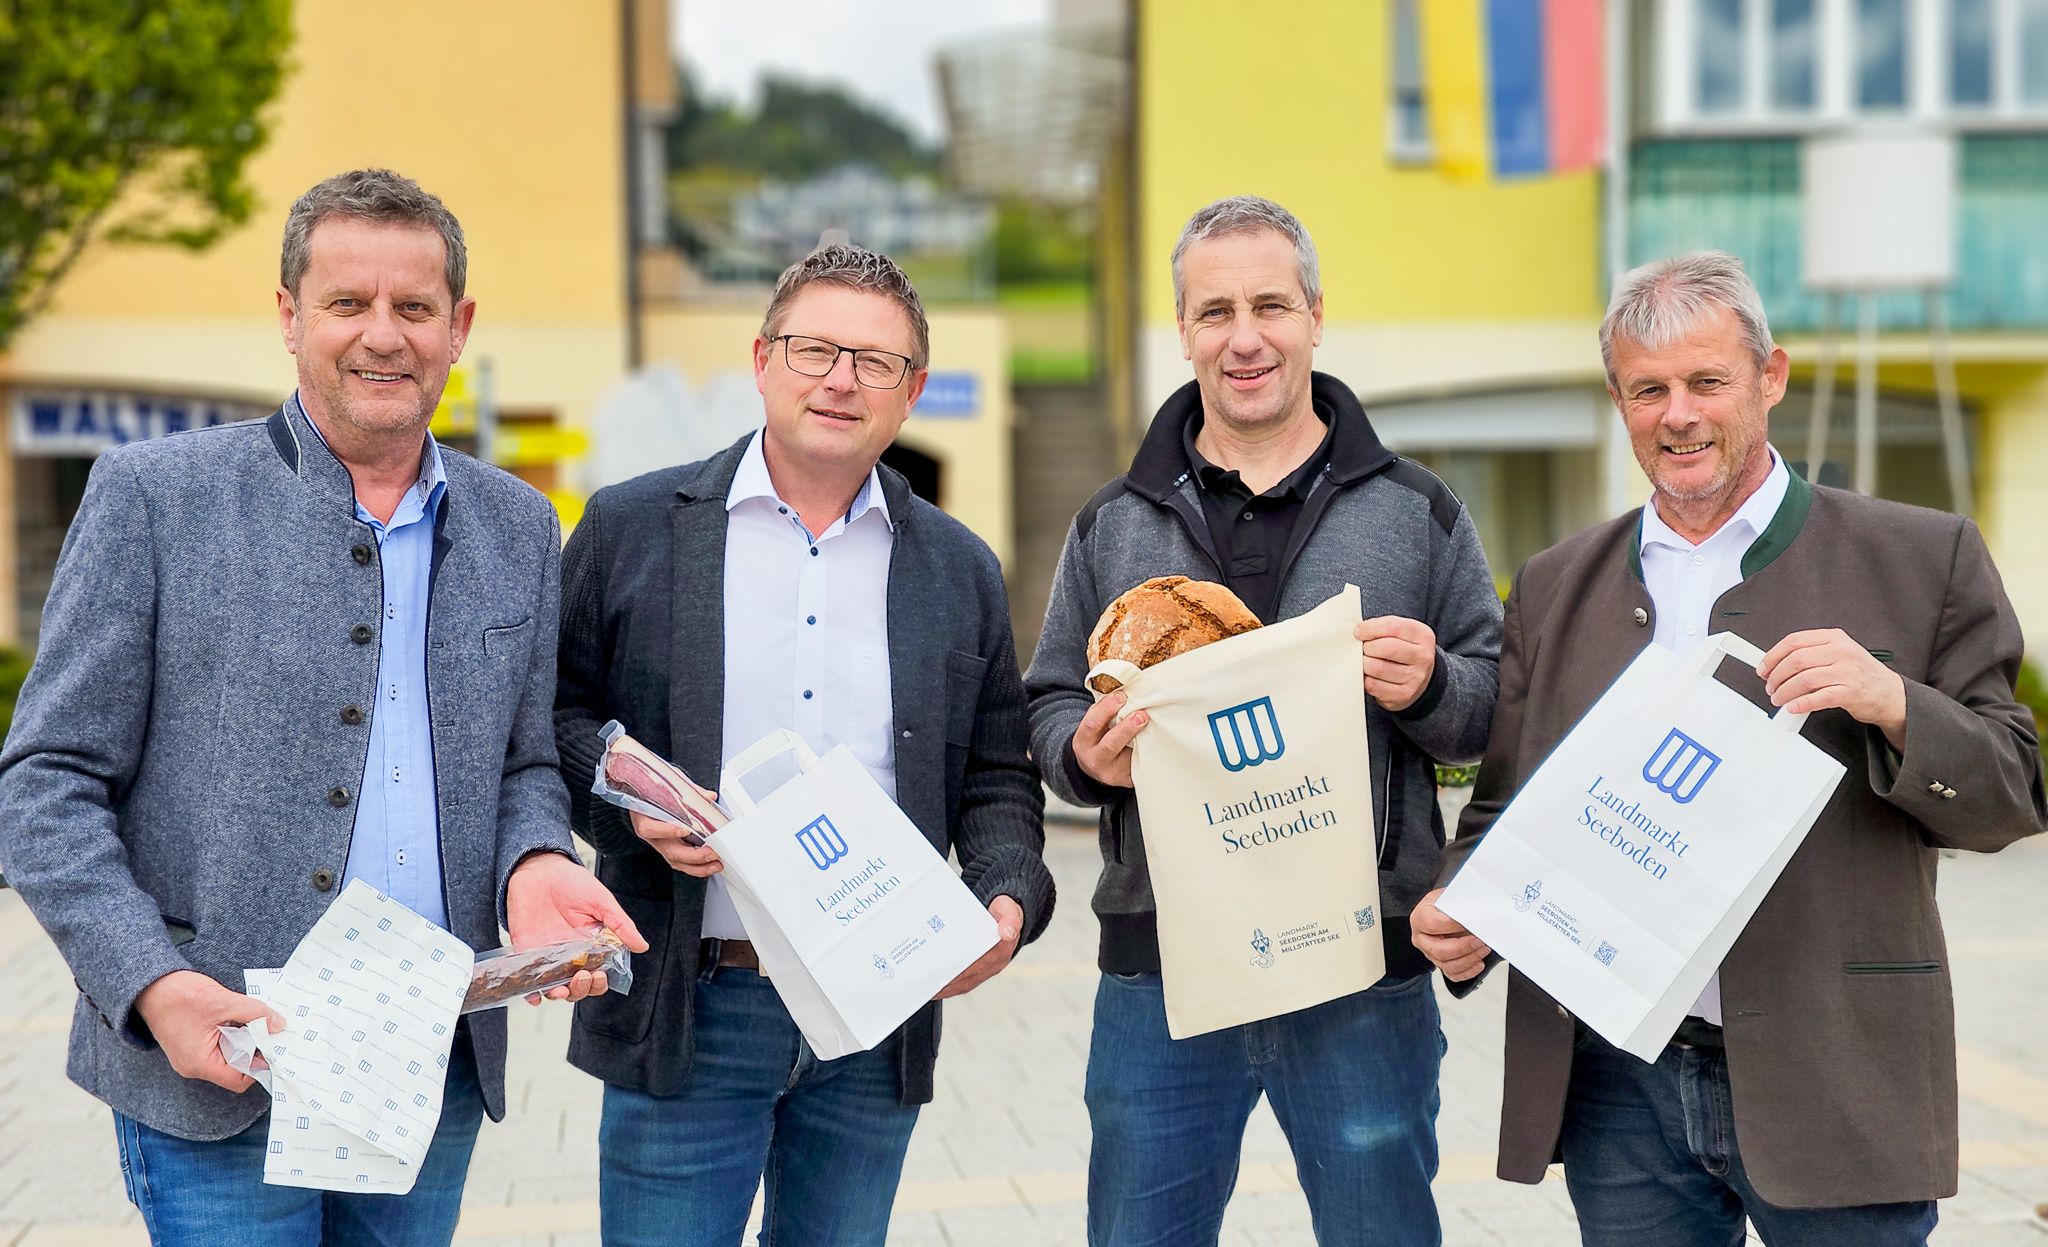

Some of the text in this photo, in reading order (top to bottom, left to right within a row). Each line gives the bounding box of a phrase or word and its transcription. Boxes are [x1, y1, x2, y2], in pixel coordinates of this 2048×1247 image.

[1202, 774, 1333, 827] Landmarkt
[1586, 774, 1691, 859] Landmarkt
[1221, 808, 1338, 855] Seeboden
[1577, 804, 1670, 881] Seeboden
[815, 855, 888, 914] Landmarkt
[834, 873, 901, 927] Seeboden
[1277, 922, 1319, 939] LANDMARKT
[1279, 928, 1329, 946] SEEBODEN AM
[1327, 933, 1341, 941] SEE
